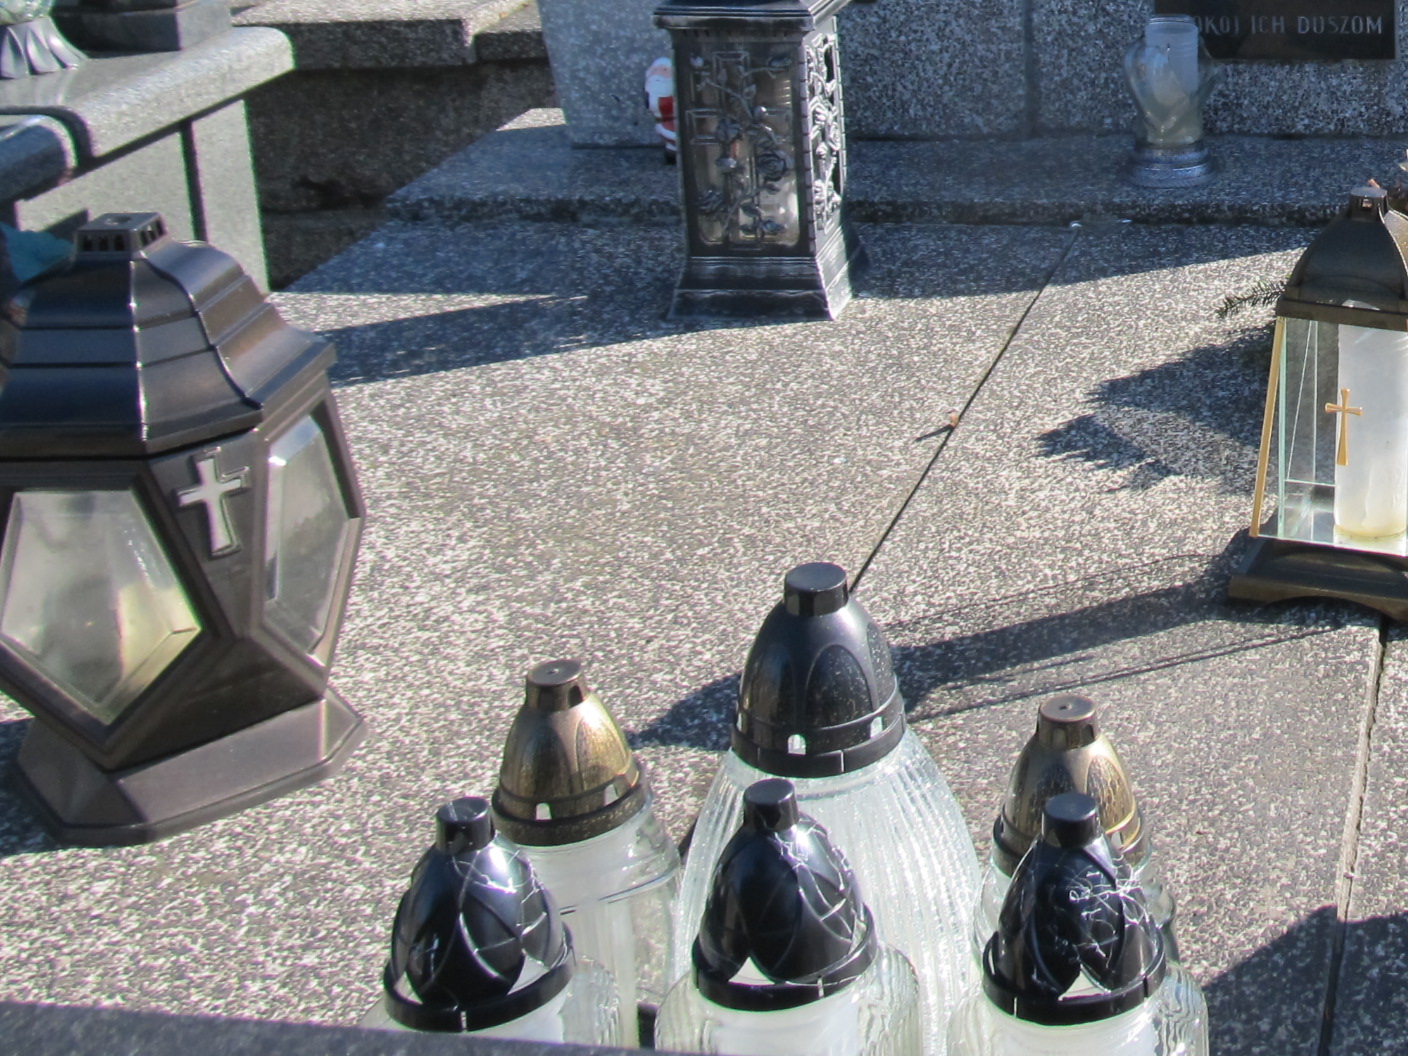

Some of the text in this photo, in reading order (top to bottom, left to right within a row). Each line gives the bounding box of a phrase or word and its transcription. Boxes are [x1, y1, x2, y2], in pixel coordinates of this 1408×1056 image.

[1194, 14, 1382, 36] OKOJ ICH DUSZOM
